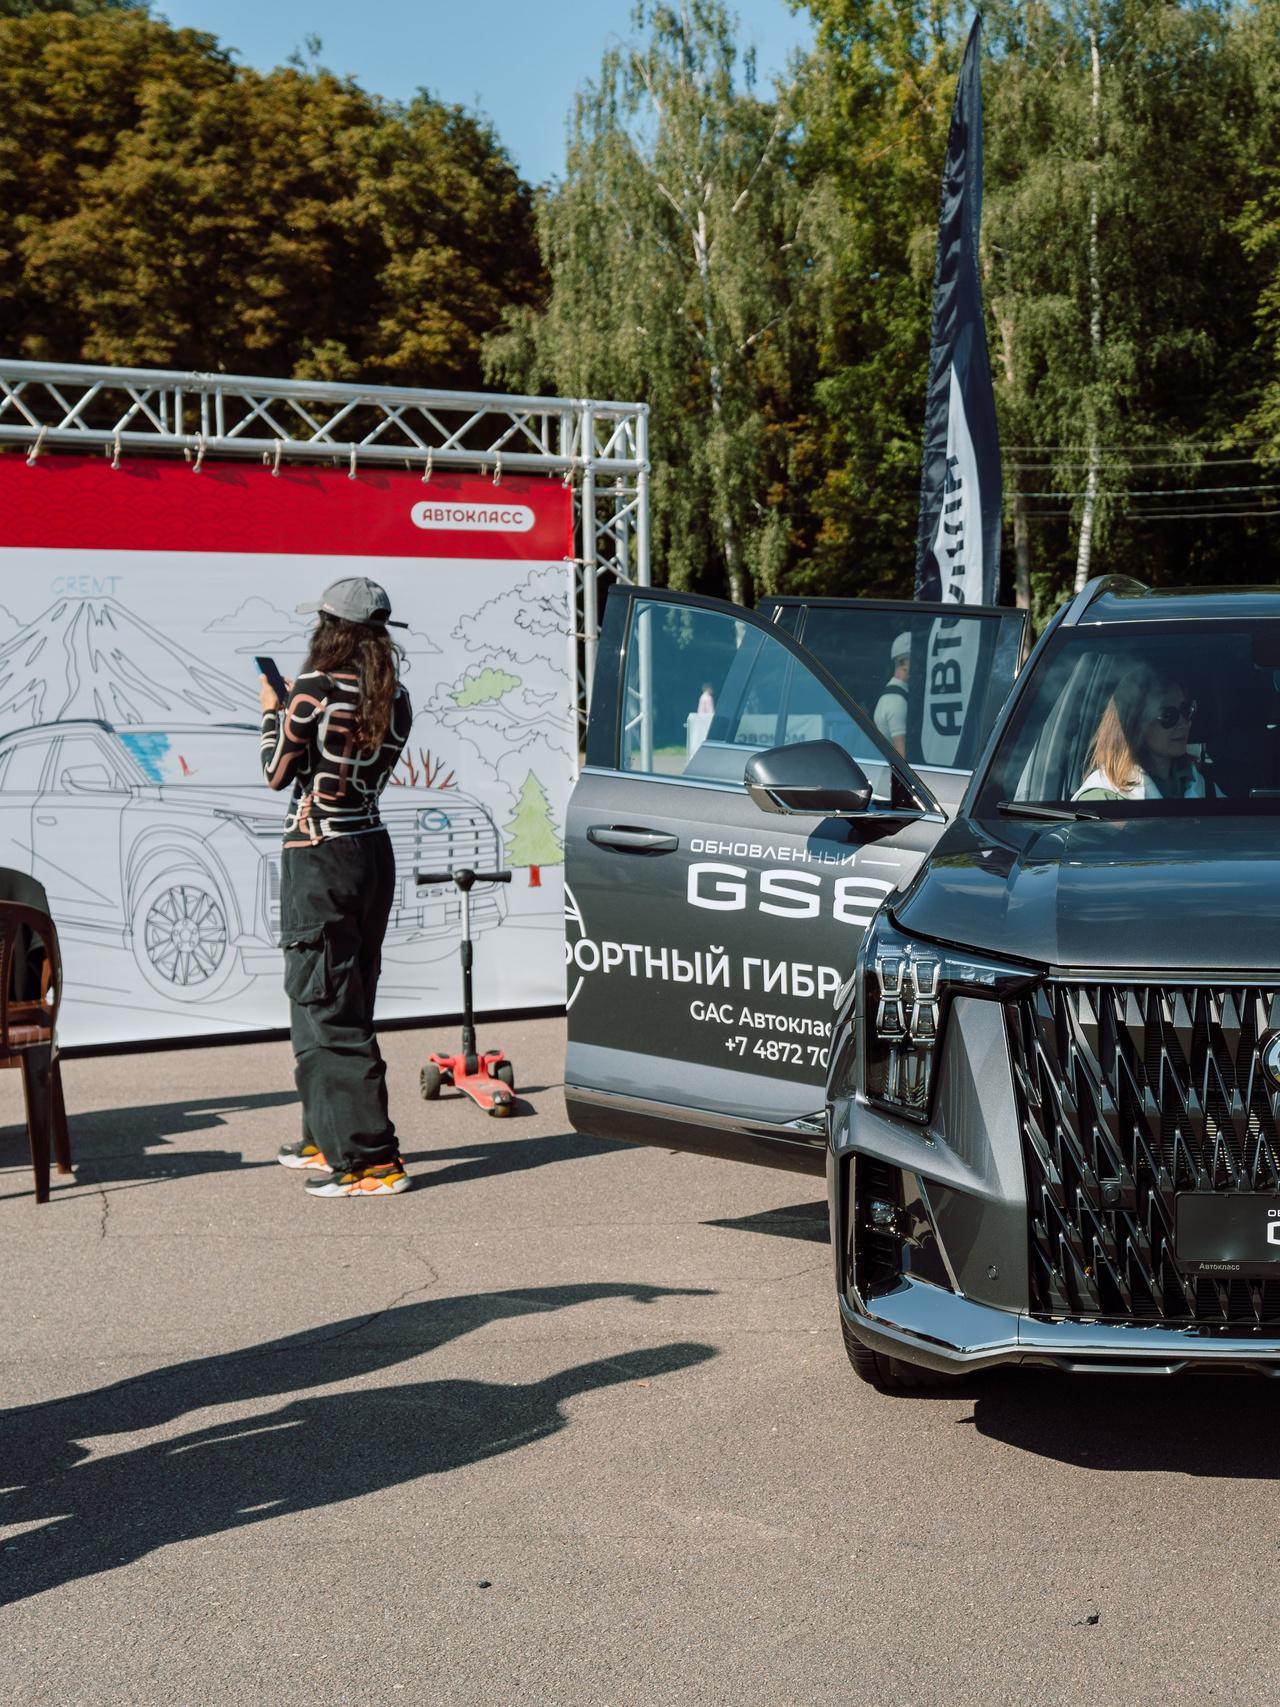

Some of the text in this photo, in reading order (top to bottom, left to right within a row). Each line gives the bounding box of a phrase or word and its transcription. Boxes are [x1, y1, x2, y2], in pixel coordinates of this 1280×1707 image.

[423, 508, 523, 524] АВТОКЛАСС
[687, 862, 895, 926] GS8
[690, 1001, 734, 1025] GAC
[725, 1036, 747, 1056] +7
[752, 1039, 803, 1065] 4872
[1199, 1262, 1240, 1271] Автокласс
